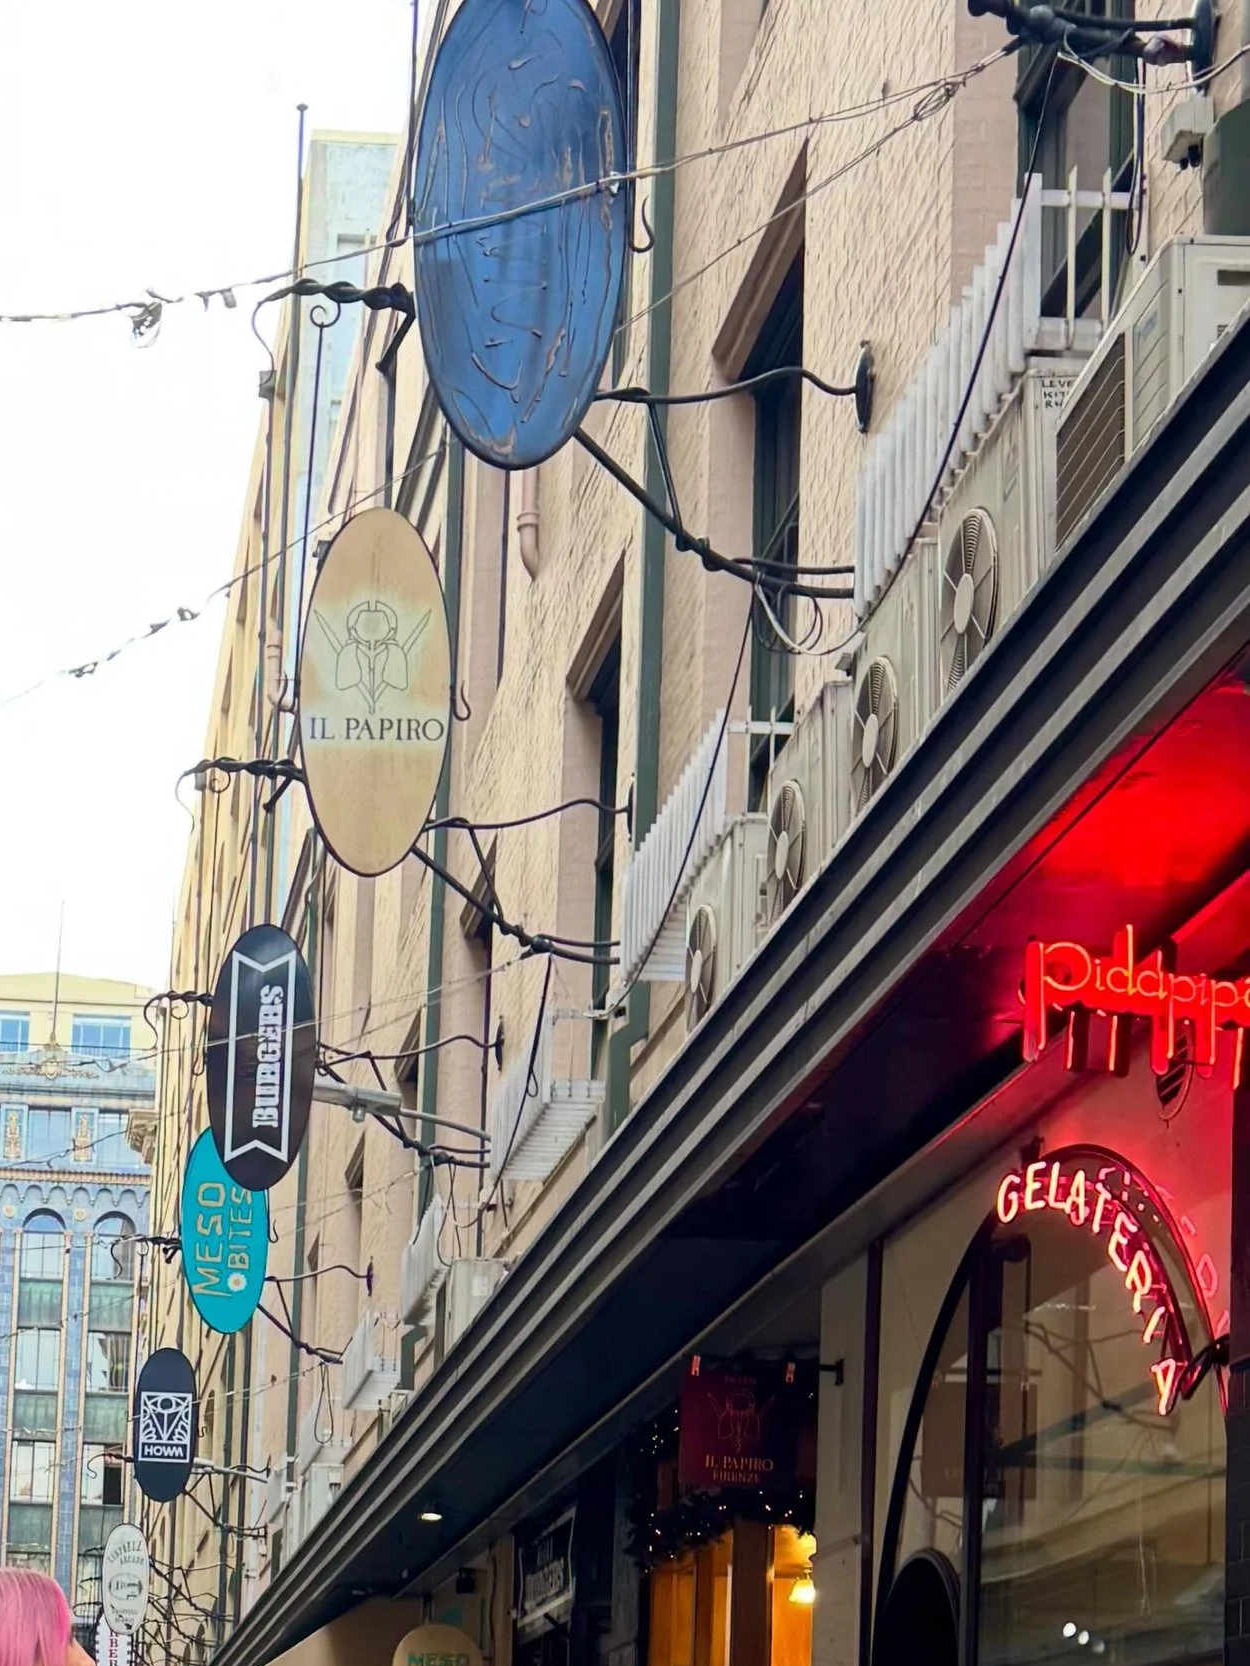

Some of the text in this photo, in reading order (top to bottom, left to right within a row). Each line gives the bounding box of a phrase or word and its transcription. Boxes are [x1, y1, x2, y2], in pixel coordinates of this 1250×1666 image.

[310, 717, 445, 742] IL PAPIRO
[252, 984, 284, 1129] BURGERS
[1036, 923, 1250, 1066] Pidapip
[191, 1182, 233, 1298] MESO
[228, 1186, 253, 1270] BITES
[996, 1160, 1178, 1418] GELATERIA
